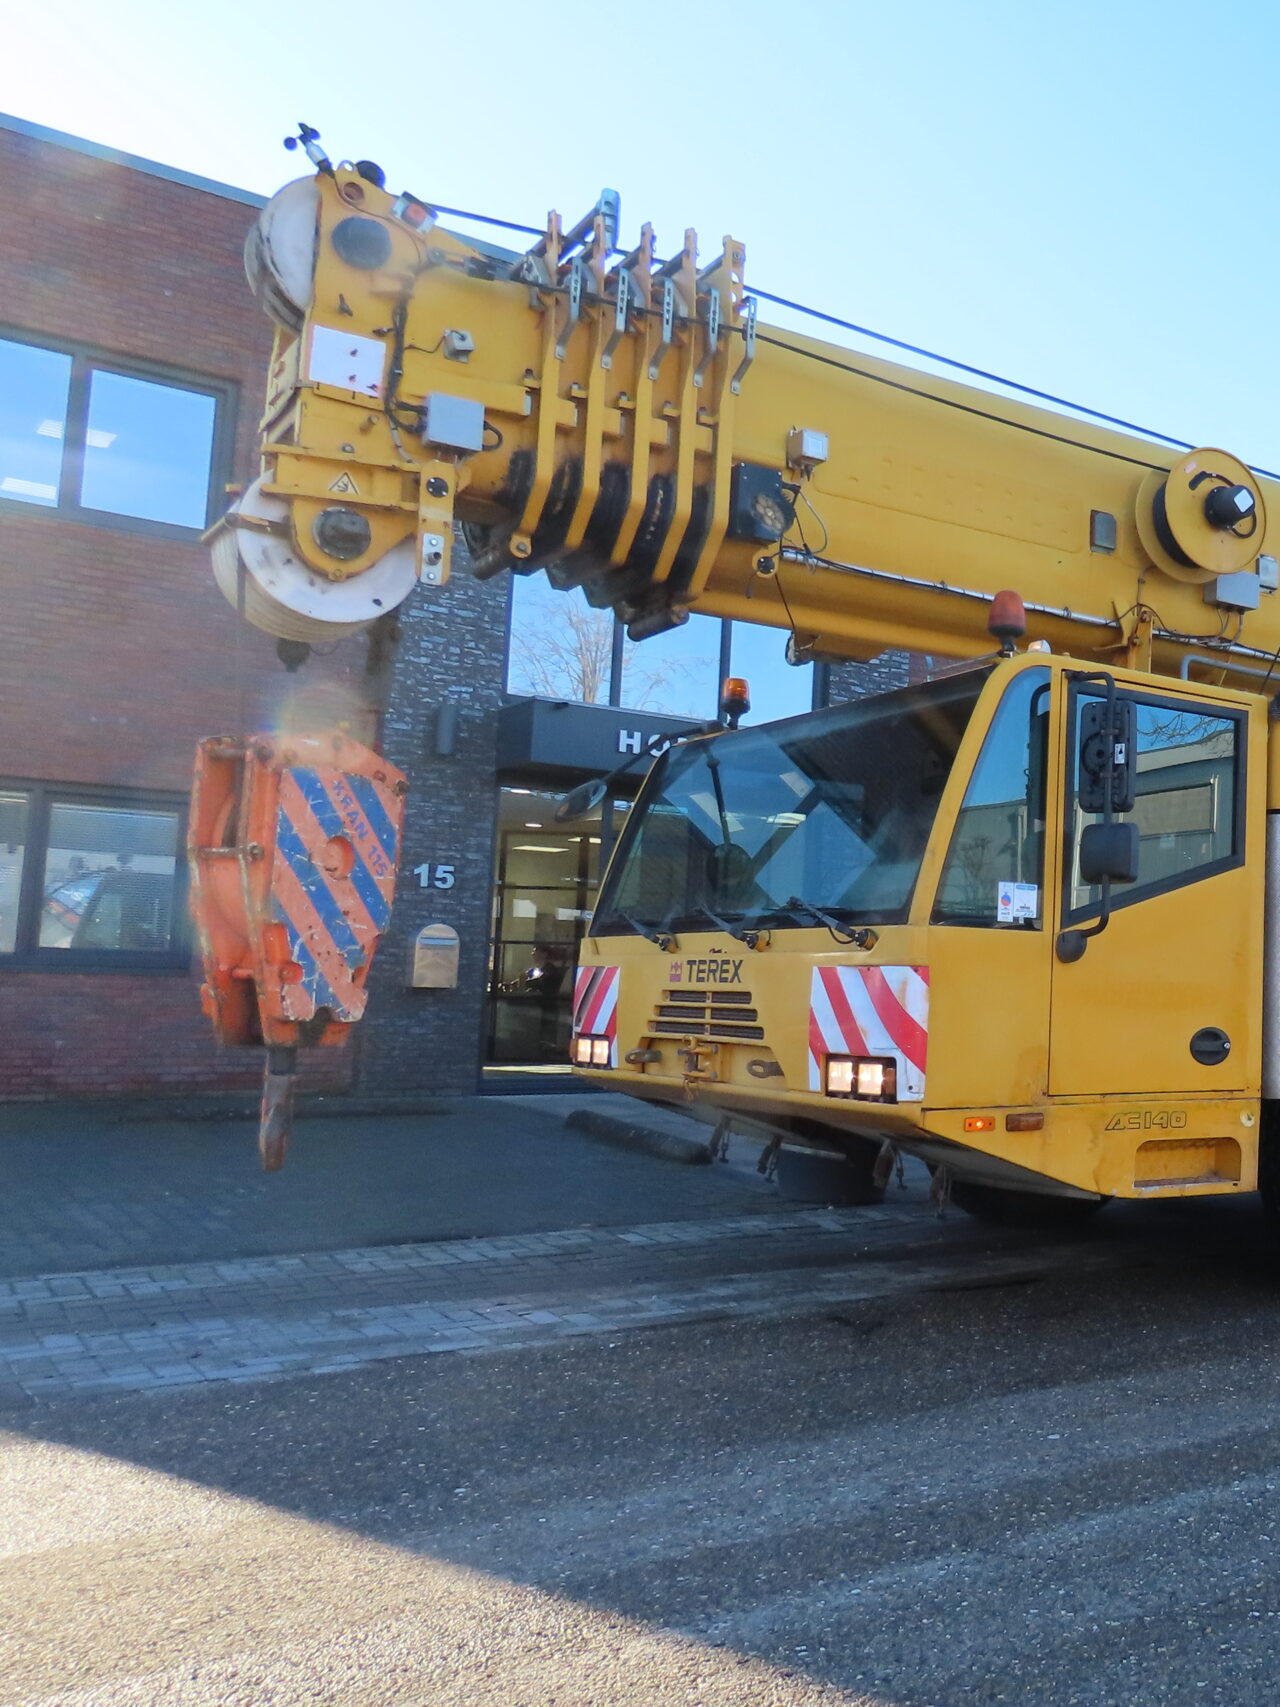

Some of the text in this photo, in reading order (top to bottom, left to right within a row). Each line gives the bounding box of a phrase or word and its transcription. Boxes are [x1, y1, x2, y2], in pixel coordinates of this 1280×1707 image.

[618, 729, 689, 758] HO
[413, 863, 456, 889] 15
[686, 959, 744, 984] TEREX
